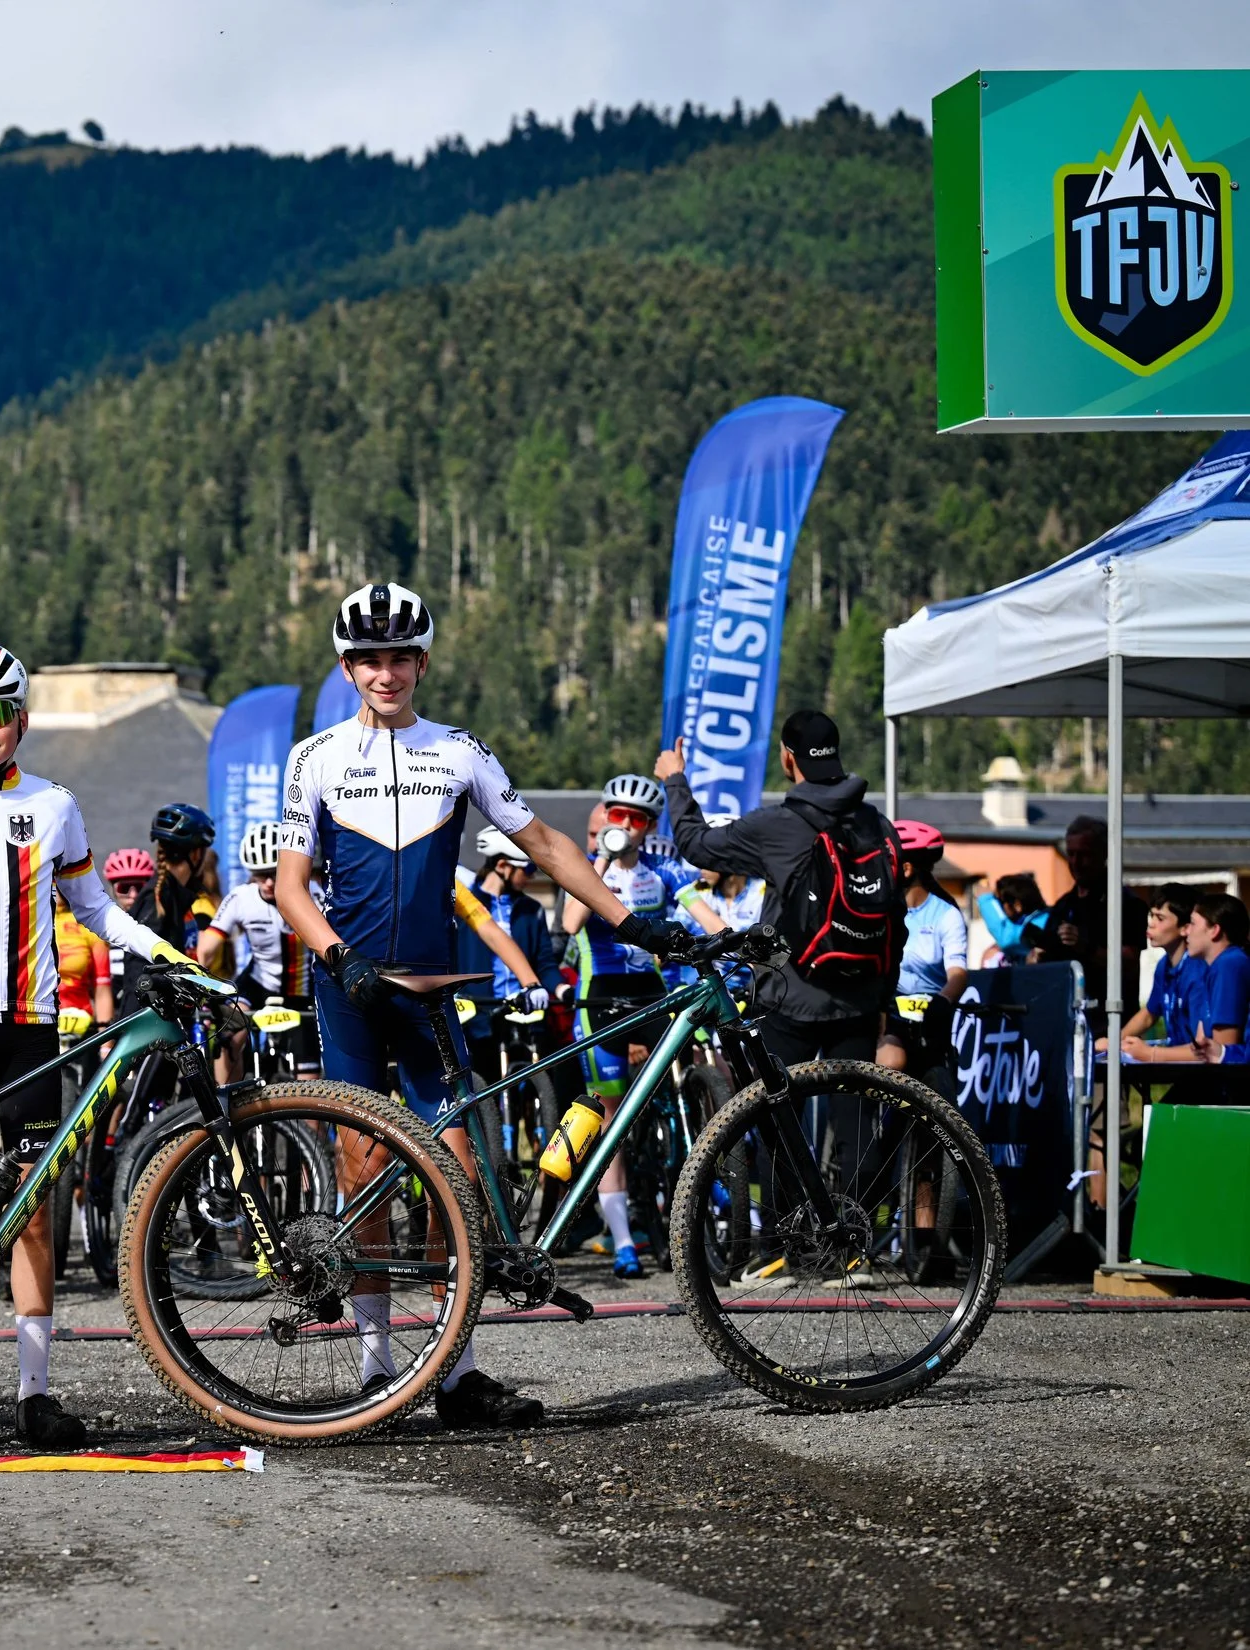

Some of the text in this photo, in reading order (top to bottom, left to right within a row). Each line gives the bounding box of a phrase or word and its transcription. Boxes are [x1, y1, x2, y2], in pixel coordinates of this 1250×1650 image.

[1072, 206, 1215, 307] TFJV
[688, 514, 731, 689] FRANÇAISE
[691, 520, 787, 819] CYCLISME
[293, 733, 334, 782] concordia
[408, 765, 456, 776] VAN RYSEL
[335, 782, 453, 800] Team Wallonie
[59, 1016, 79, 1033] 17
[354, 1109, 422, 1156] SCHWALBE RICK XC
[931, 1124, 954, 1147] SWISS
[0, 1058, 122, 1251] SCOTT
[388, 1266, 419, 1274] bikerun.lu
[729, 1328, 751, 1350] SWISS
